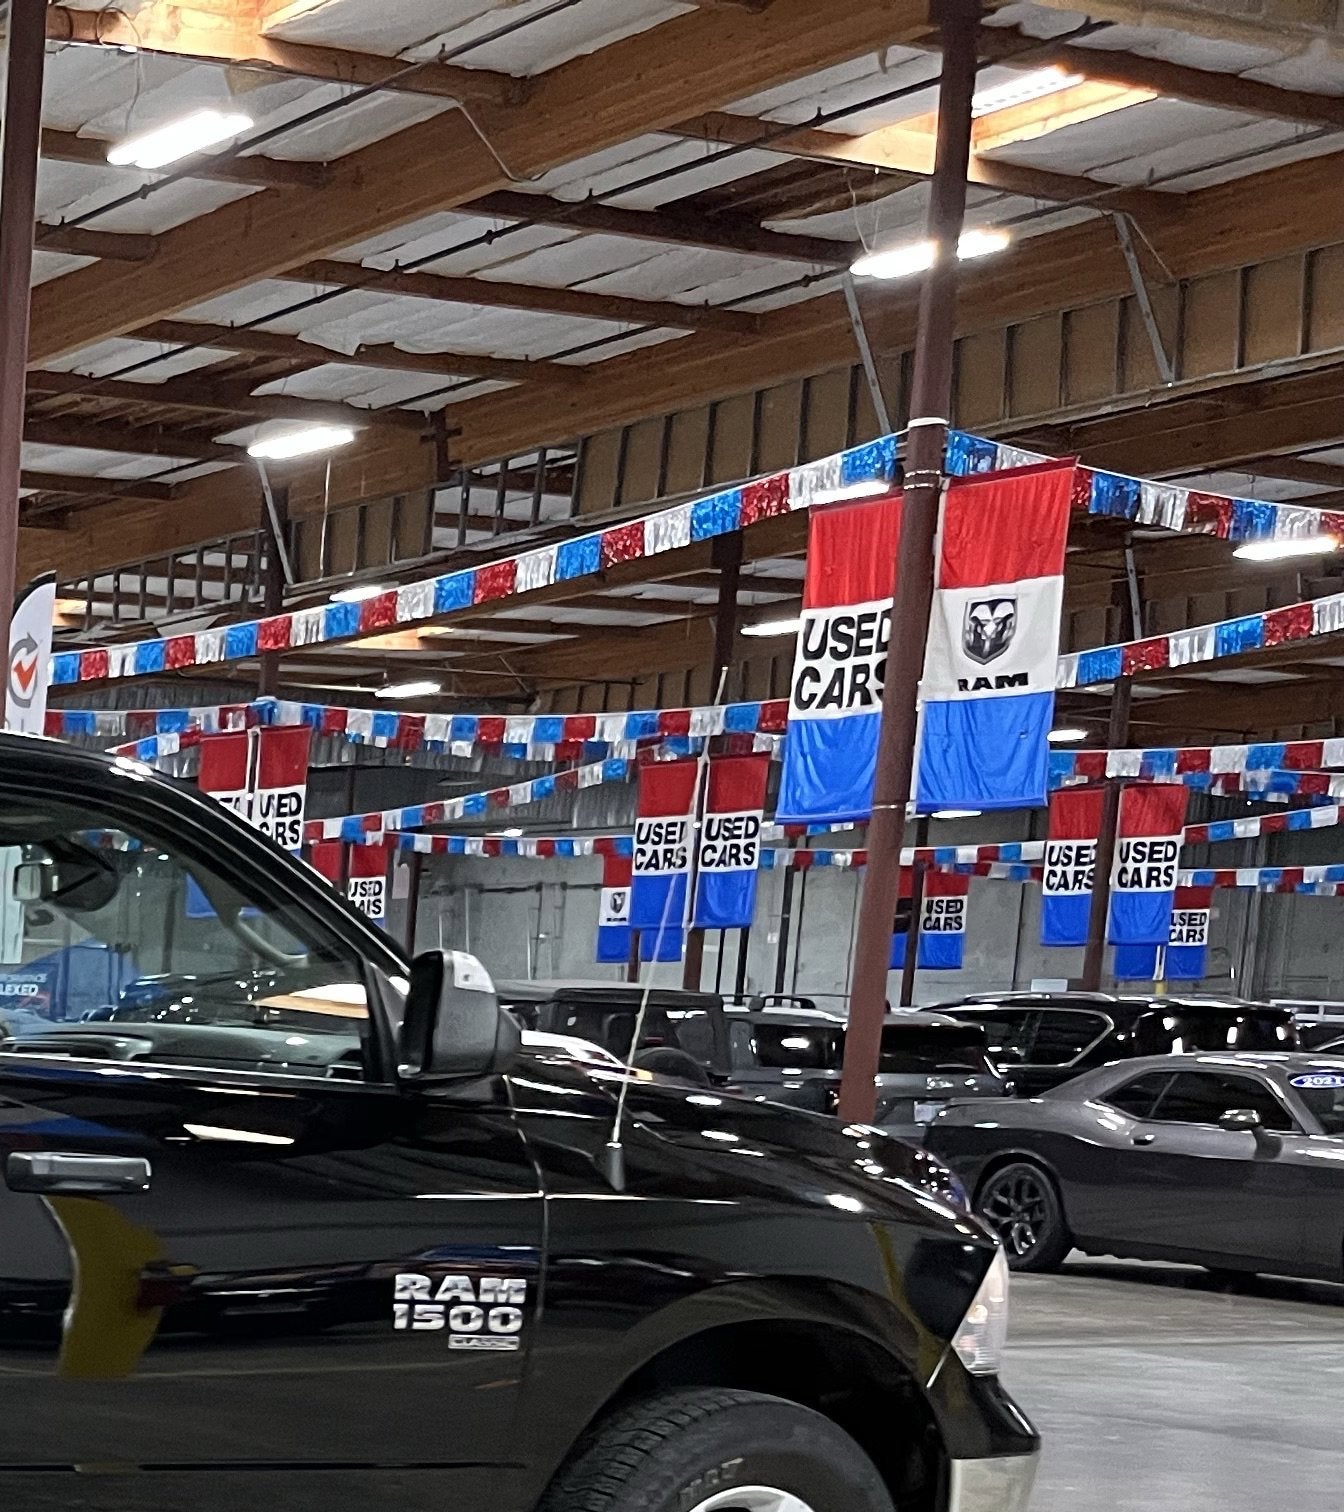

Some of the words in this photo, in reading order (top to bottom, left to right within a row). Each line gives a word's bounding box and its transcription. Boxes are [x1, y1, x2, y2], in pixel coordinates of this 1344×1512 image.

[958, 672, 1029, 692] RAM
[260, 792, 302, 818] UED
[705, 816, 759, 841] USED
[701, 842, 756, 867] CARS
[1119, 841, 1177, 864] USED
[1117, 865, 1174, 888] CARS
[926, 899, 964, 914] USED
[923, 916, 963, 931] CARS
[1302, 1076, 1342, 1087] 2021
[393, 1273, 527, 1304] RAM
[393, 1303, 523, 1333] 1500
